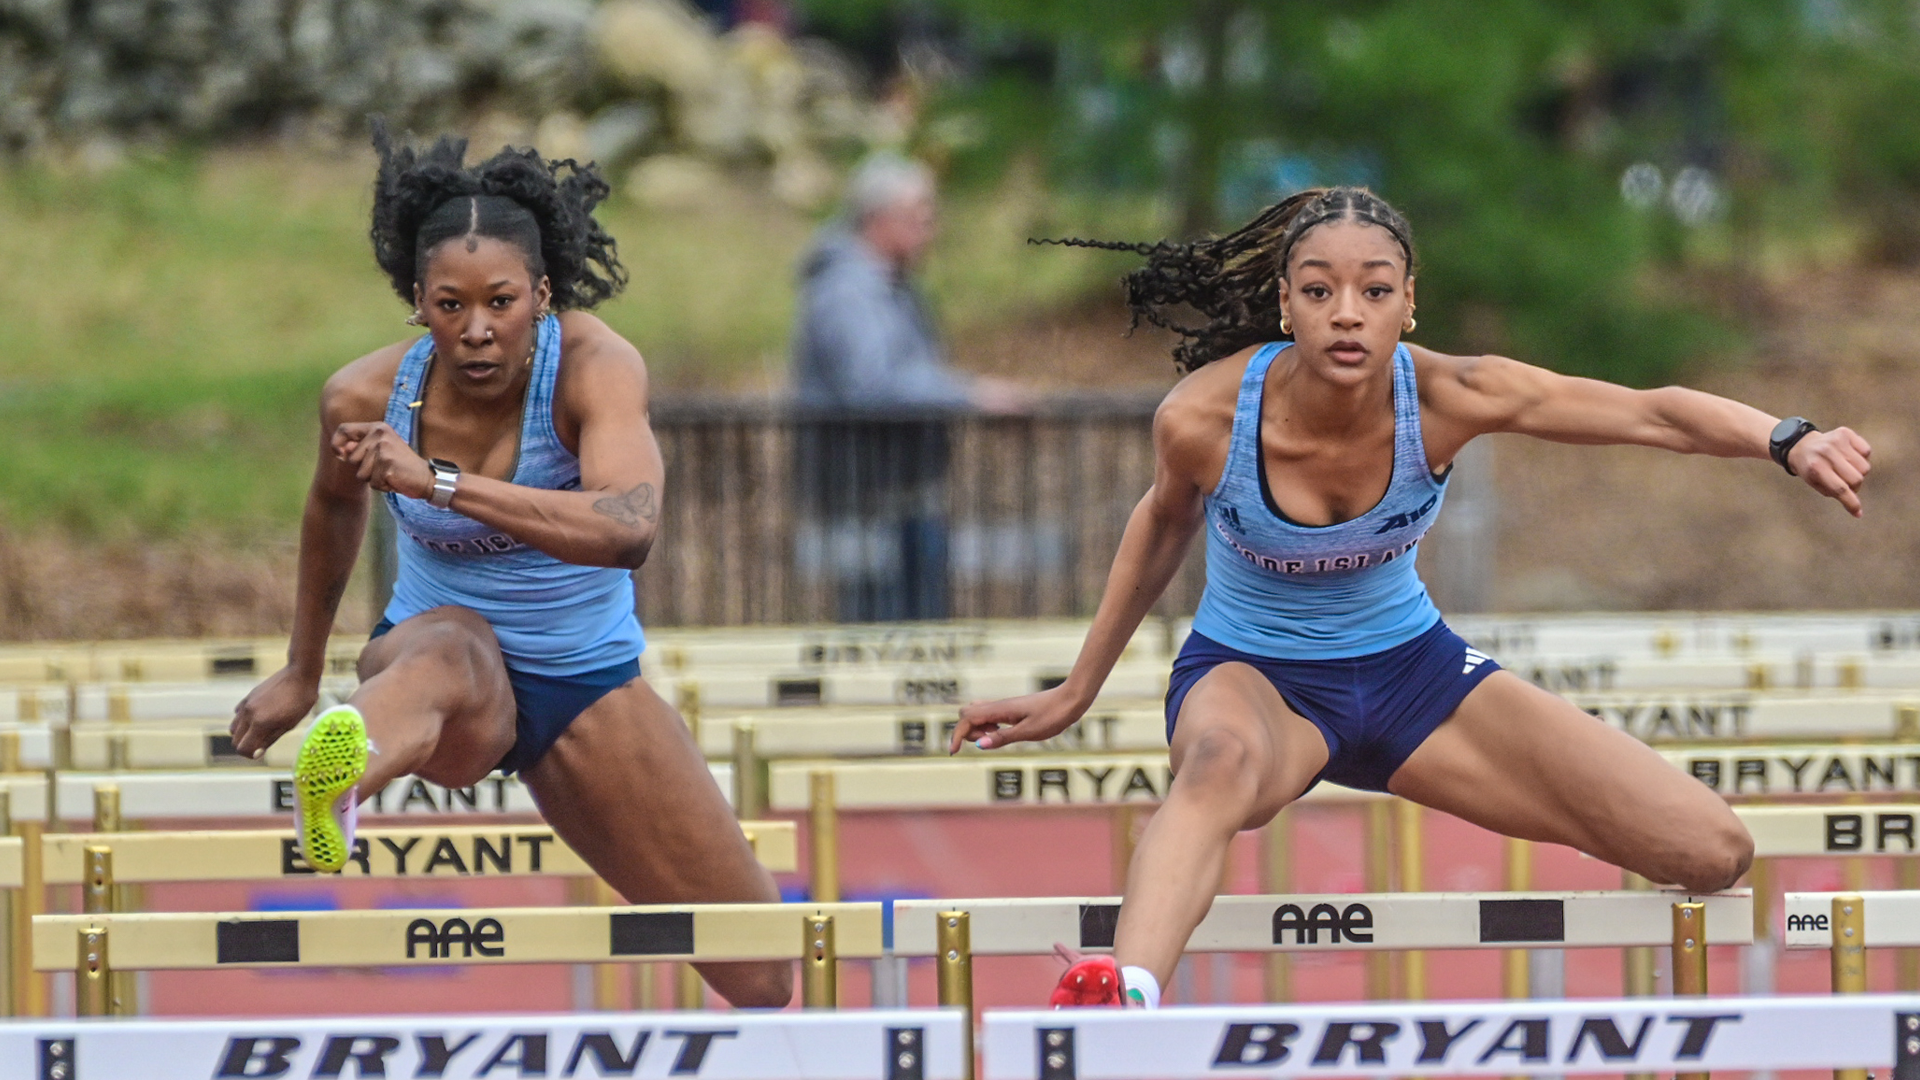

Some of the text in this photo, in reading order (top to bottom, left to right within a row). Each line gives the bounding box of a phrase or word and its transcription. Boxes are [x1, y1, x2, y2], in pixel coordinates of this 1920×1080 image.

[991, 767, 1174, 802] BRYA
[212, 1029, 739, 1080] BRYANT
[1210, 1014, 1742, 1068] BRYANT
